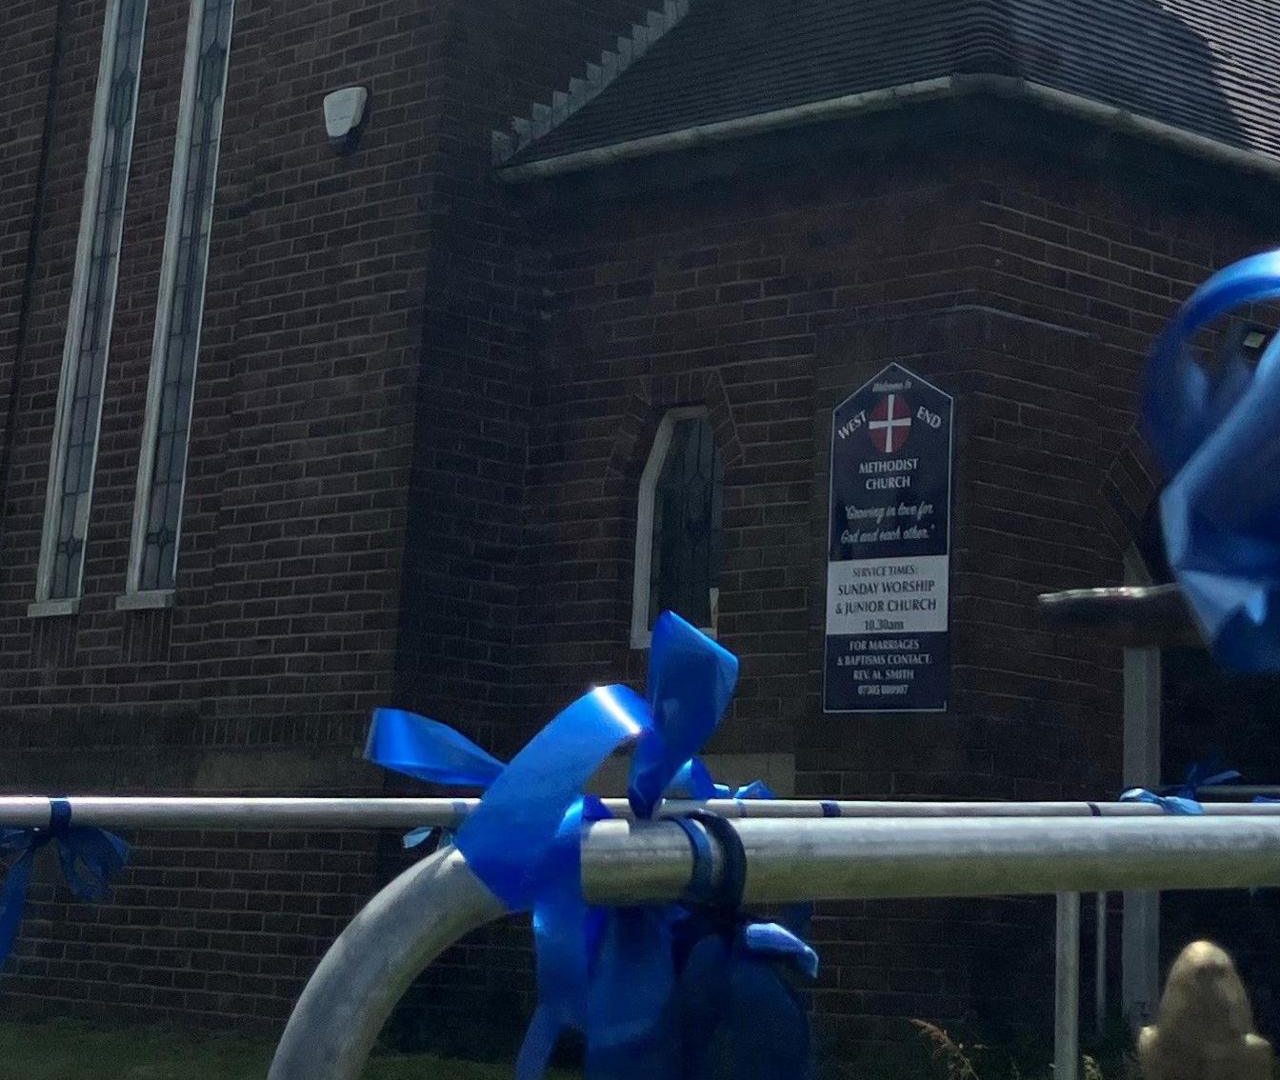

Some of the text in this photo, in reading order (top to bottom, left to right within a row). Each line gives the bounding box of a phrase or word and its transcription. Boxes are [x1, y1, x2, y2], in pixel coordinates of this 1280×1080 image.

[838, 406, 942, 440] WEST END
[859, 458, 919, 474] METHODIST
[865, 476, 911, 490] CHURCH
[886, 505, 896, 517] in
[898, 502, 917, 516] love
[917, 501, 934, 521] for
[840, 529, 859, 544] God
[860, 528, 879, 542] and
[880, 526, 901, 541] each
[853, 565, 918, 577] SERVICE TIMES:
[838, 579, 936, 596] SUNDAY WORSHIP
[835, 598, 937, 615] & JUNIOR CHURCH
[864, 619, 905, 631] 10.30am
[849, 639, 920, 651] FOR MARRIAGES
[837, 656, 844, 666] &
[844, 655, 886, 666] BAPTISMS
[885, 669, 914, 680] SMITH
